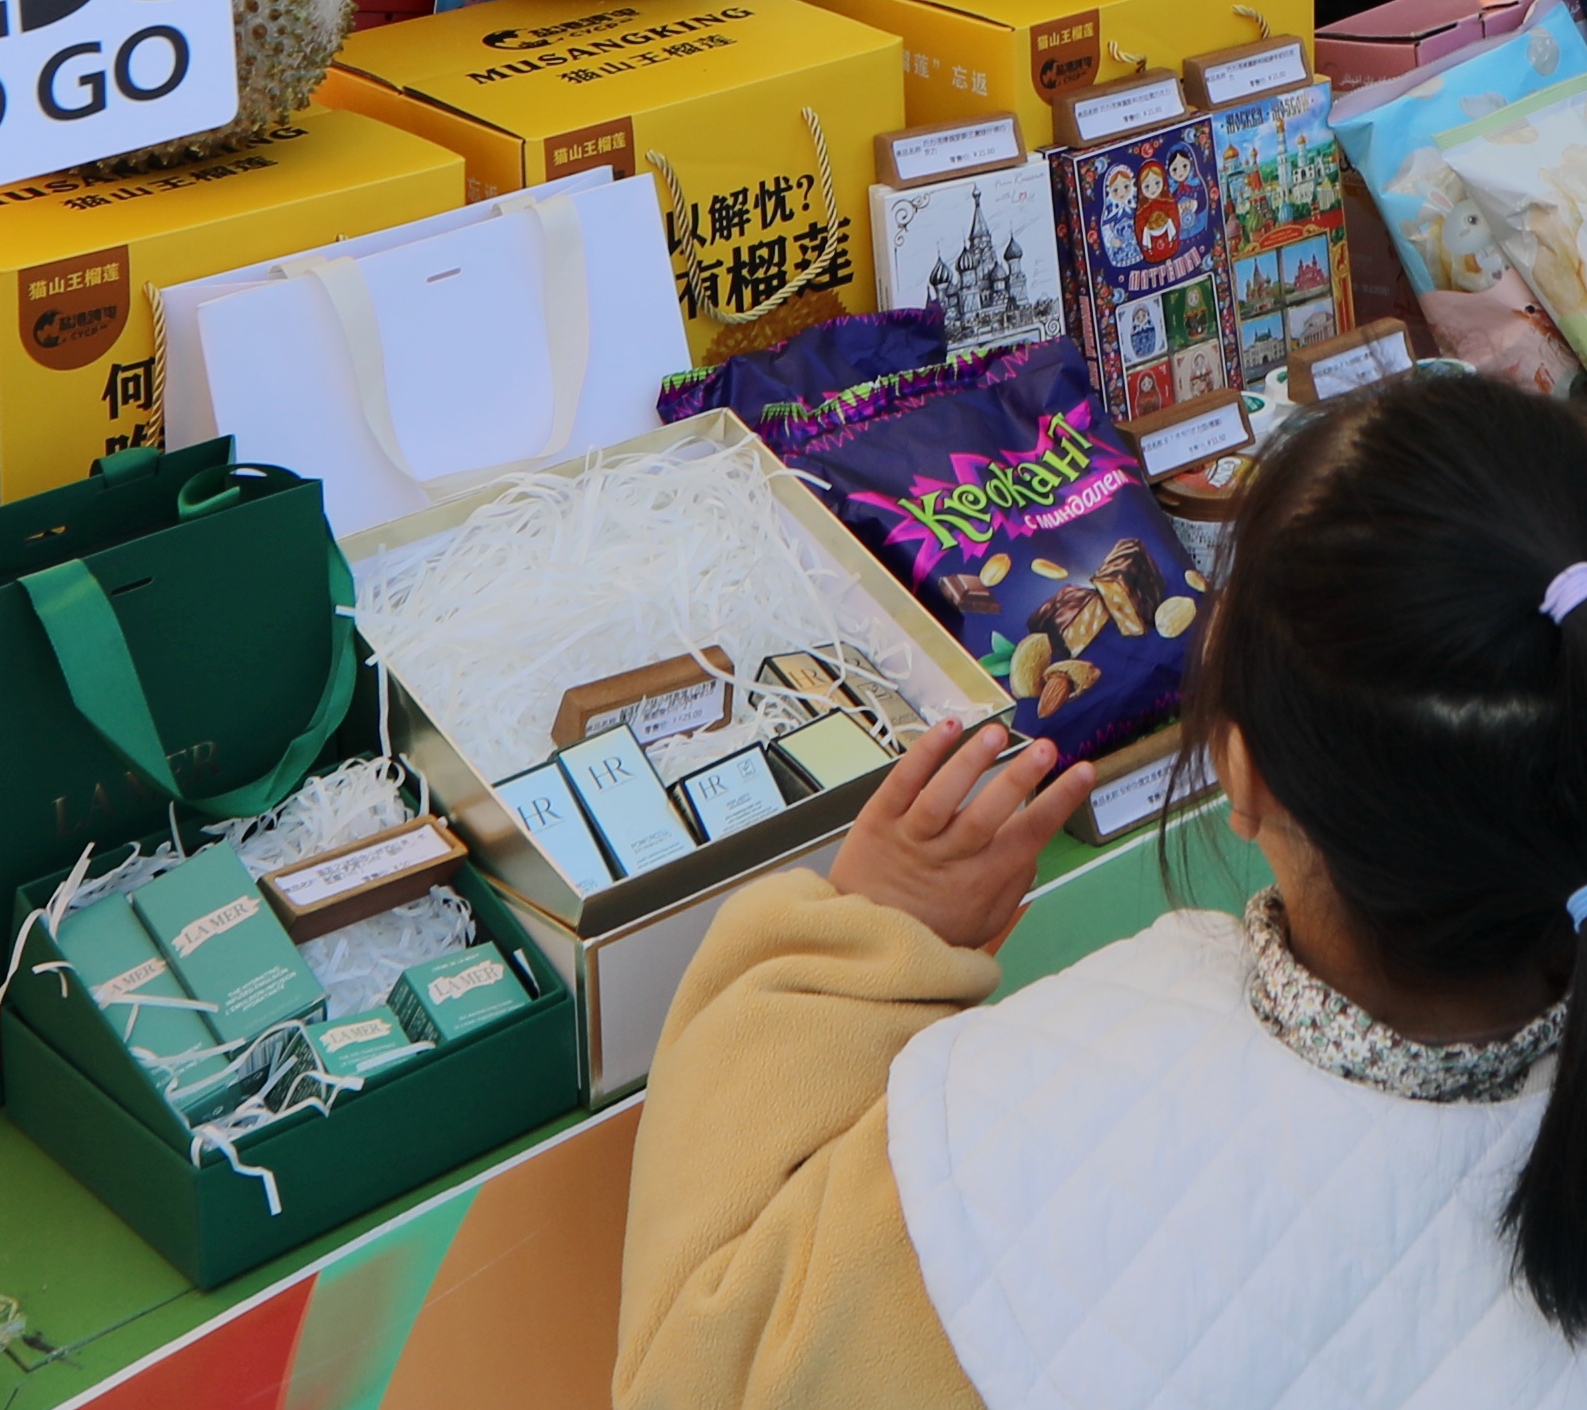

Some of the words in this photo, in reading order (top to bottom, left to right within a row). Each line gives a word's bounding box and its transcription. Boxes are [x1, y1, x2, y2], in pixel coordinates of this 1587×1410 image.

[465, 5, 756, 86] MUSANGKING
[559, 33, 738, 86] 猫山王榴莲
[34, 21, 194, 124] GO
[61, 153, 280, 212] 猫山王榴莲
[1034, 468, 1130, 530] миндалем
[587, 755, 636, 792] HR
[696, 774, 728, 801] HR
[516, 796, 565, 833] HR
[181, 921, 212, 946] LA
[212, 899, 252, 935] MER
[122, 961, 157, 989] MER
[433, 976, 462, 1000] LA
[461, 963, 500, 987] MER
[330, 1030, 351, 1045] LA
[350, 1022, 382, 1039] MER
